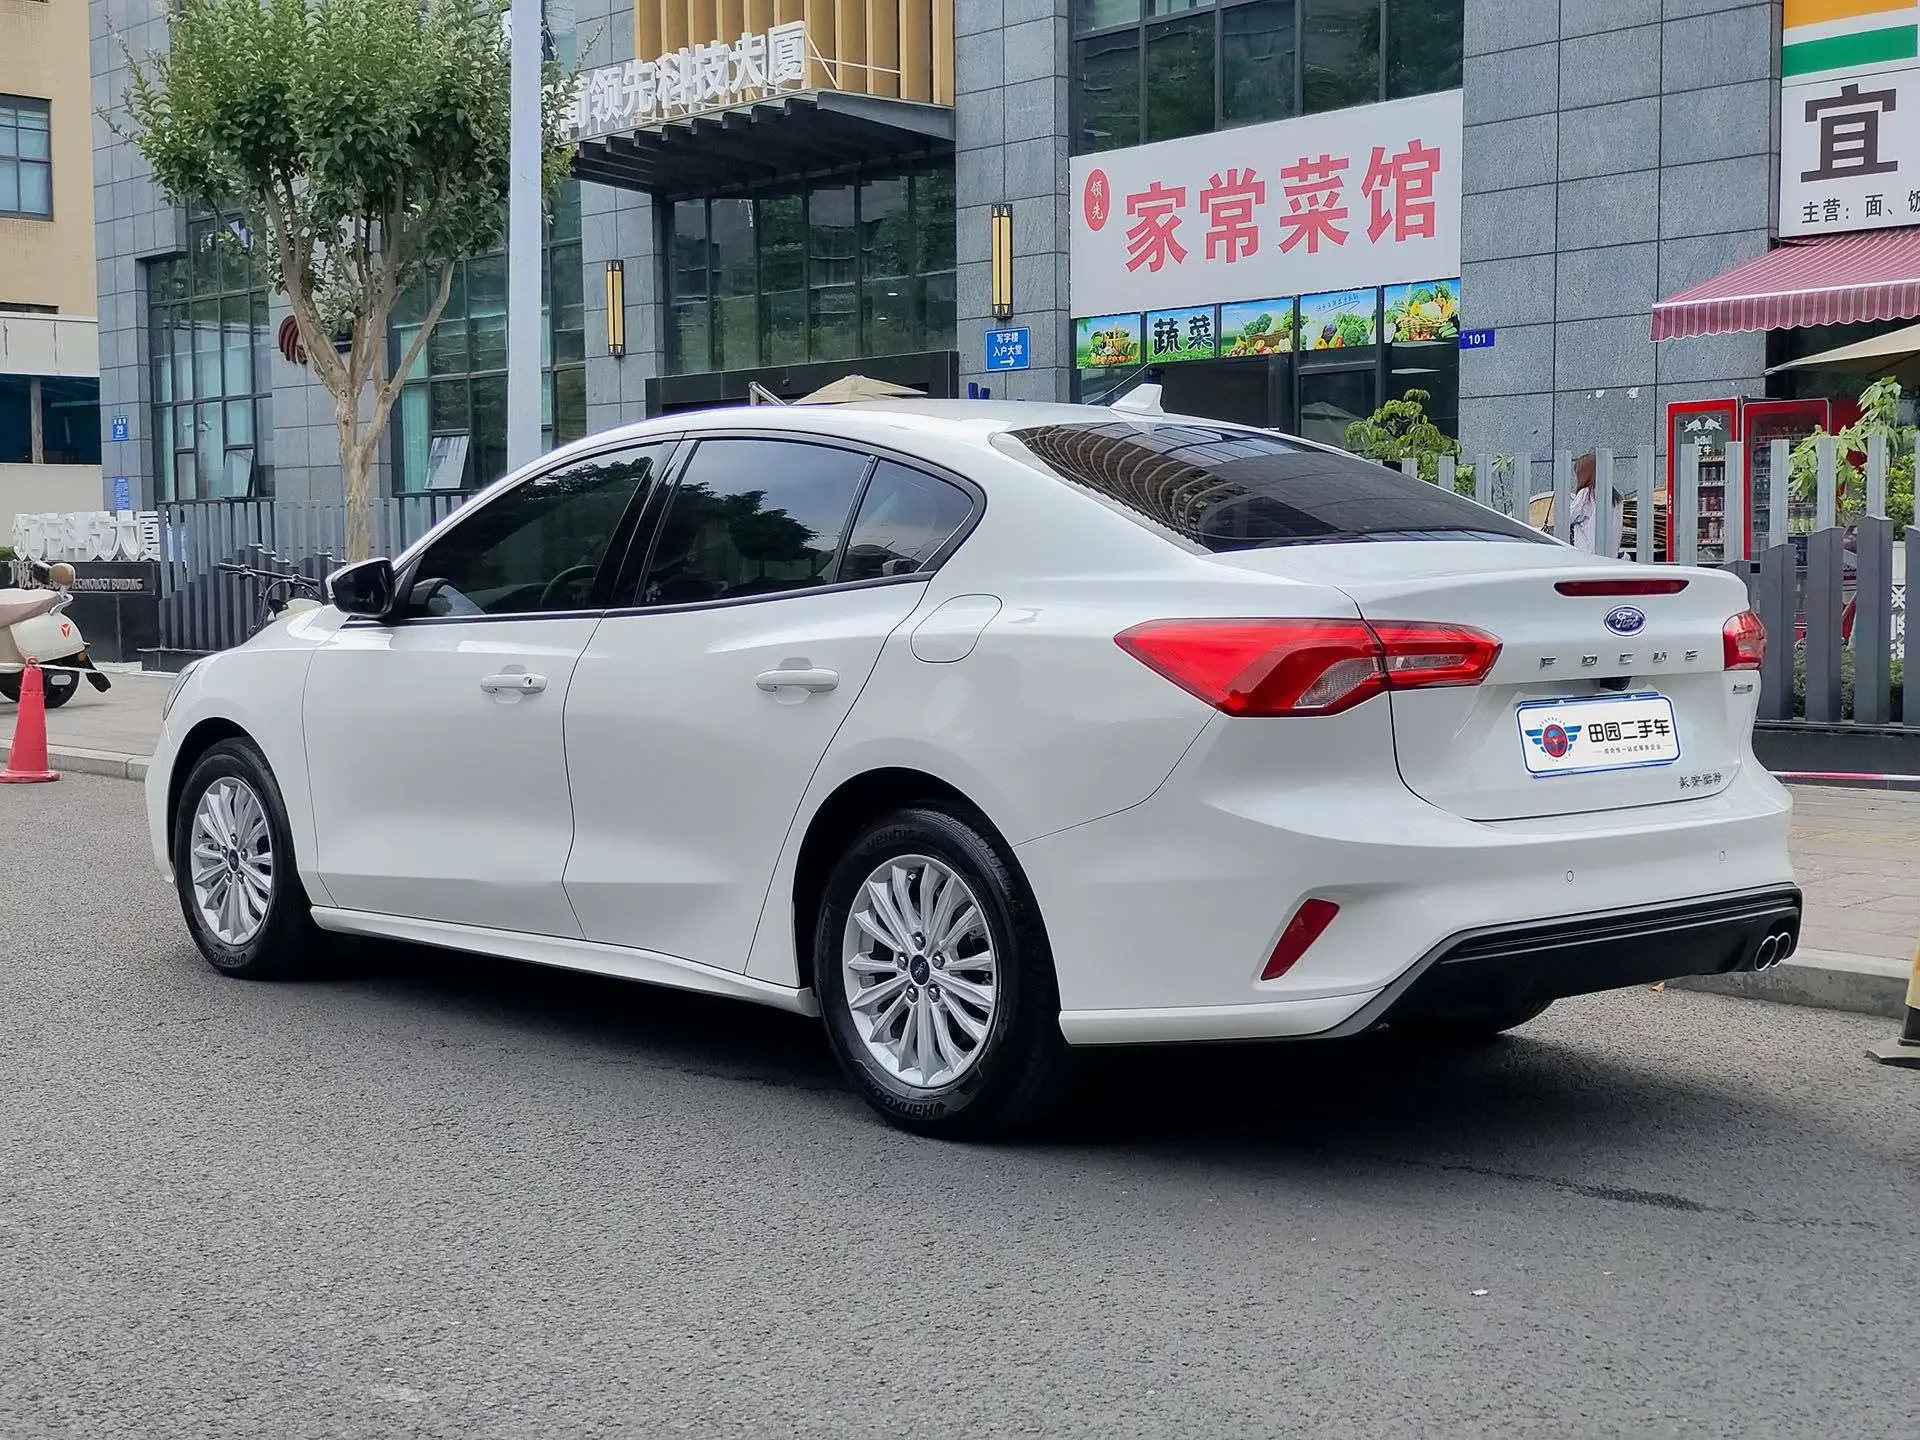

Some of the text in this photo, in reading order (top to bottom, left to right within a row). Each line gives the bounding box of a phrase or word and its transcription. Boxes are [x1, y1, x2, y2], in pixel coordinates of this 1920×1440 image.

[1801, 83, 1898, 183] 宜
[1090, 180, 1104, 221] 领先
[1125, 138, 1441, 273] 家常菜馆
[993, 345, 1023, 357] 入户大堂
[996, 332, 1019, 344] 写字楼
[1153, 314, 1214, 356] 蔬菜
[1469, 333, 1486, 345] 101
[1588, 719, 1671, 743] 田园二手车
